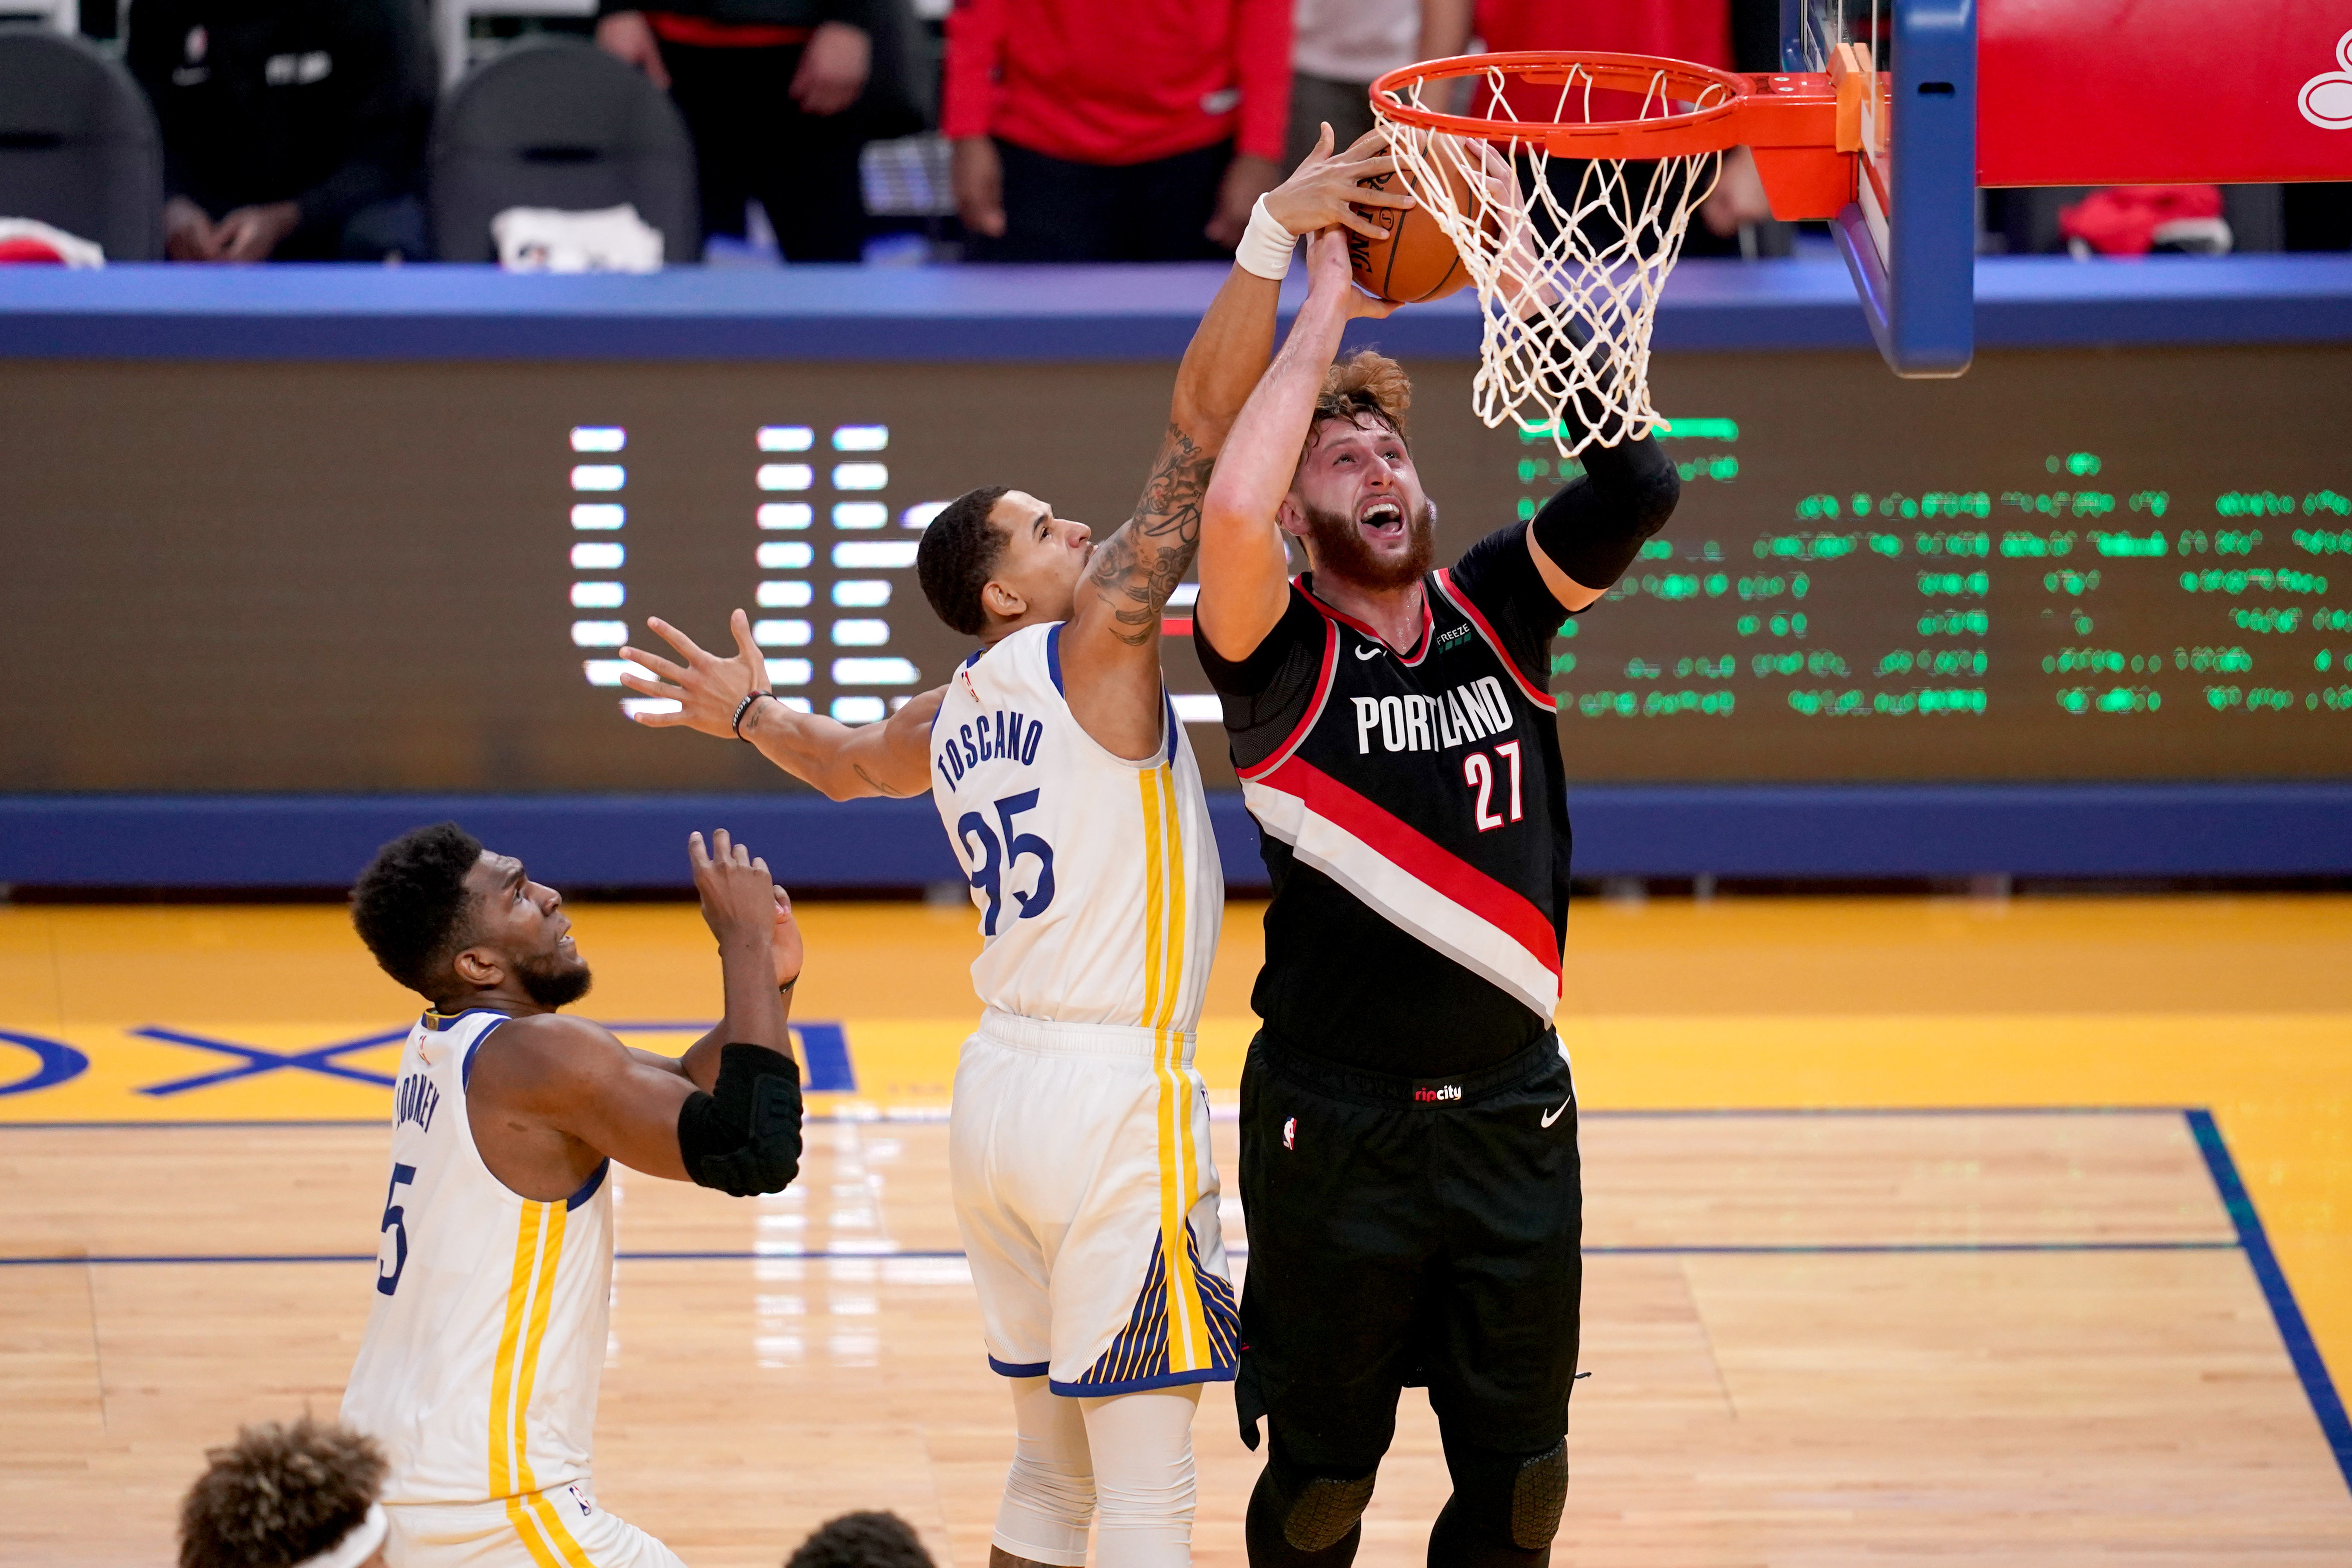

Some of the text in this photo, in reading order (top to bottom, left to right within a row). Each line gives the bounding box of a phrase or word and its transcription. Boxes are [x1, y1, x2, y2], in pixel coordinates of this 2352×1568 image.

[1436, 623, 1470, 646] FREEZE
[938, 710, 1043, 794] TOSCANO
[1350, 676, 1513, 754] PORTLAND
[1463, 739, 1524, 833] 27
[958, 787, 1056, 936] 95
[1415, 1084, 1462, 1102] ripcity
[377, 1162, 417, 1296] 5
